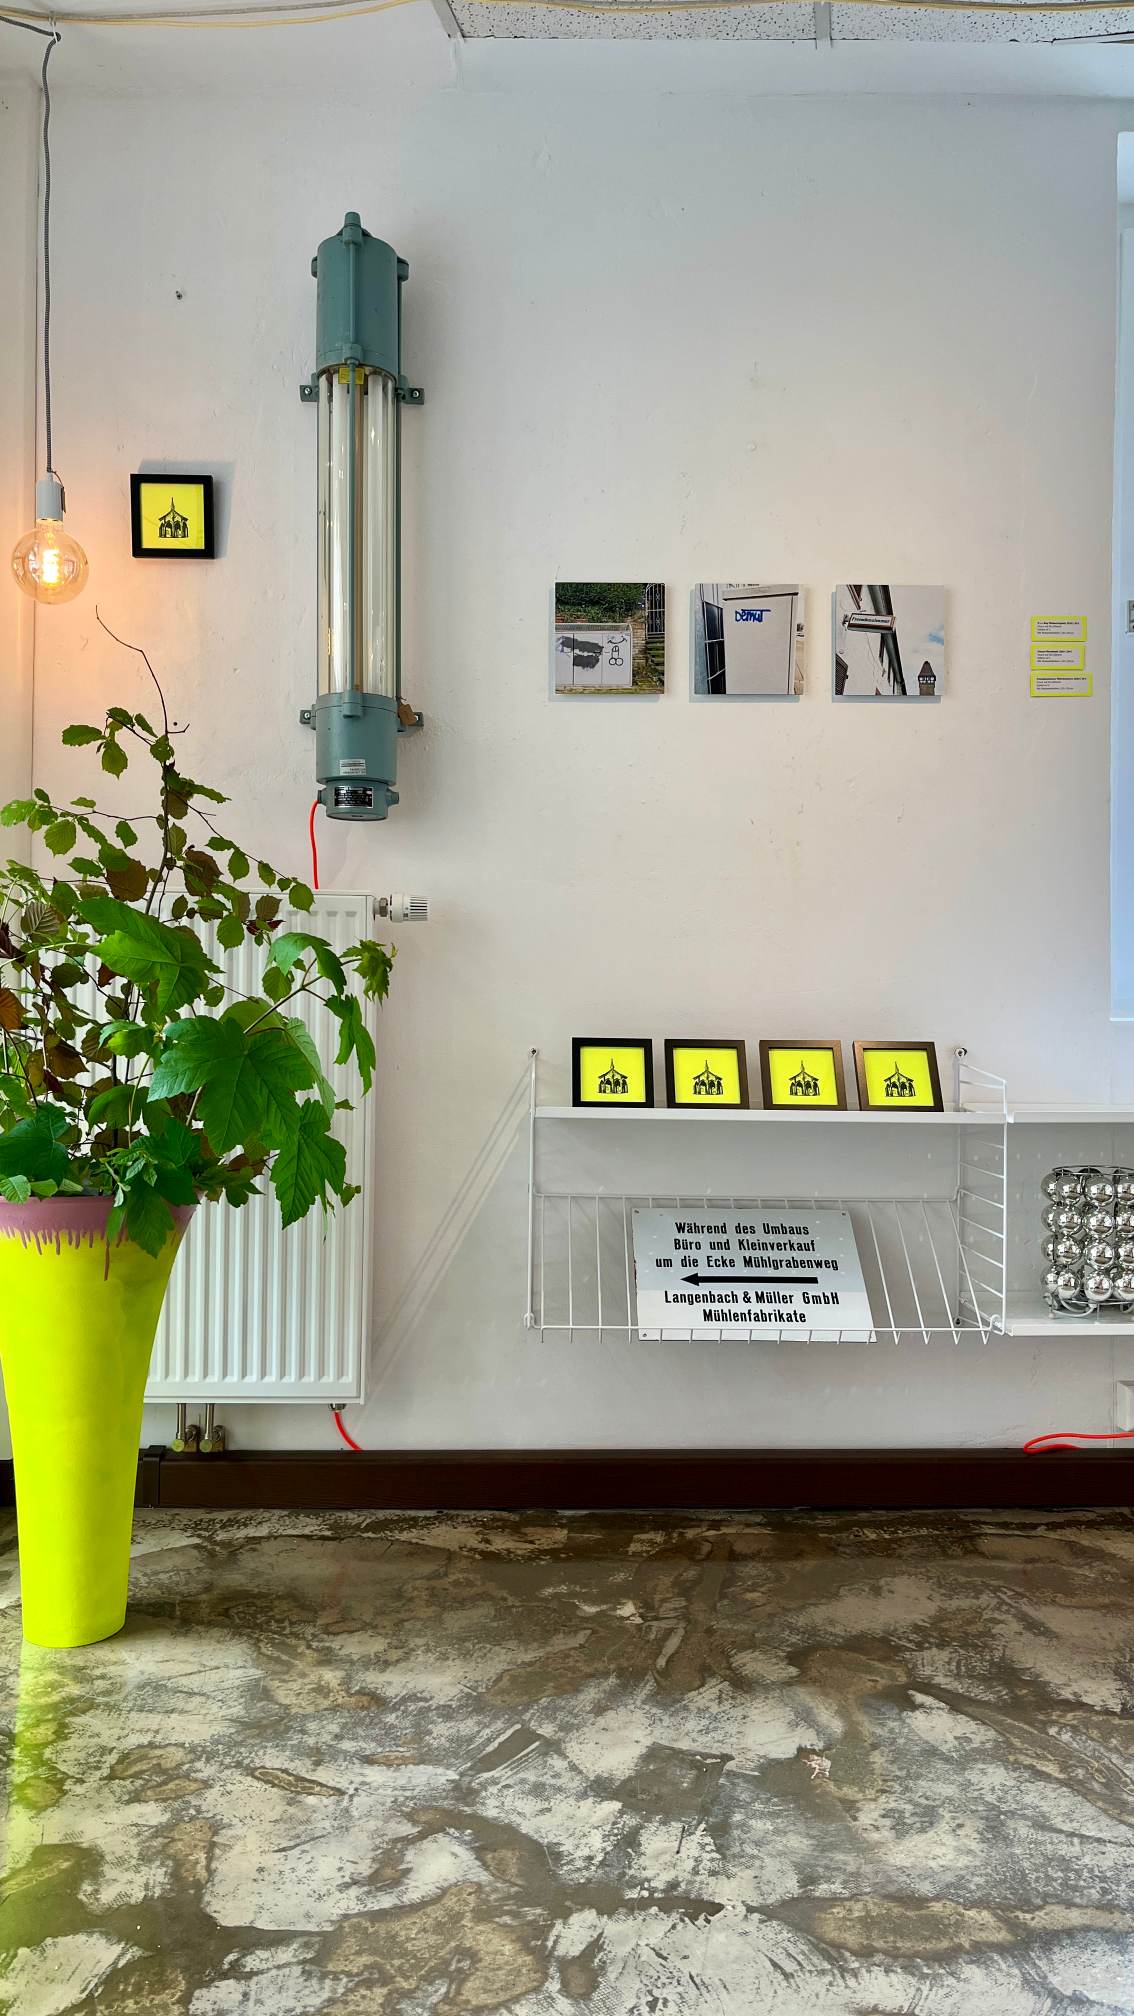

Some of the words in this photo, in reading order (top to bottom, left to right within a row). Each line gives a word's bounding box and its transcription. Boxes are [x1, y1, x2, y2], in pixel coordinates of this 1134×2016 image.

[674, 1221, 728, 1235] Während
[734, 1222, 757, 1235] des
[762, 1222, 810, 1236] Umbaus
[673, 1238, 702, 1251] Büro
[708, 1238, 731, 1251] und
[737, 1238, 816, 1252] Kleinverkauf
[655, 1258, 673, 1268] um
[680, 1255, 699, 1268] die
[706, 1255, 736, 1268] Ecke
[742, 1255, 839, 1272] Mühlgrabenweg
[664, 1290, 739, 1306] Langenbach
[742, 1290, 752, 1304] &
[754, 1290, 794, 1304] Müller
[801, 1291, 840, 1305] GmbH
[702, 1308, 807, 1323] Mühlenfabrikate
